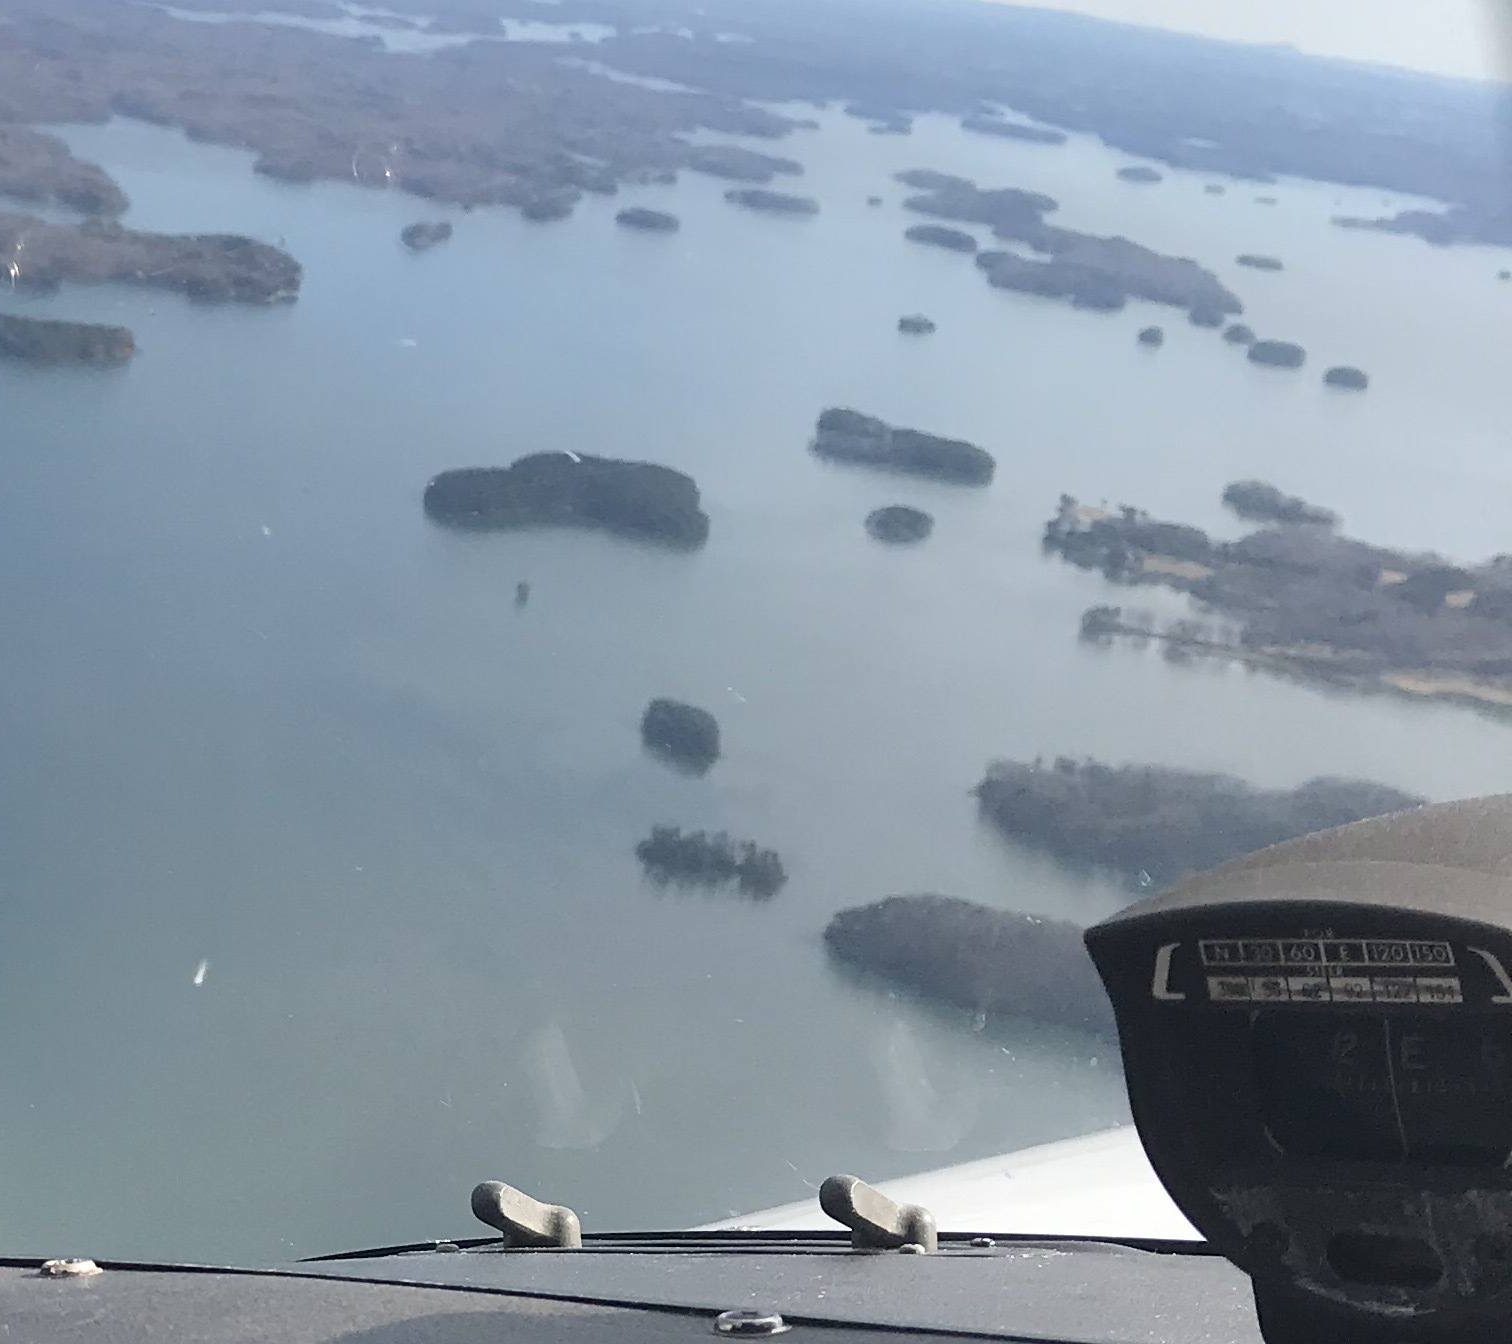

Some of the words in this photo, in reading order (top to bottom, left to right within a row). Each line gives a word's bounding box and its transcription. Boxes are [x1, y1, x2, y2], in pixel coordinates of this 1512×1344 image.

[1290, 944, 1316, 962] 60
[1371, 944, 1404, 963] 120
[1413, 944, 1447, 963] 150
